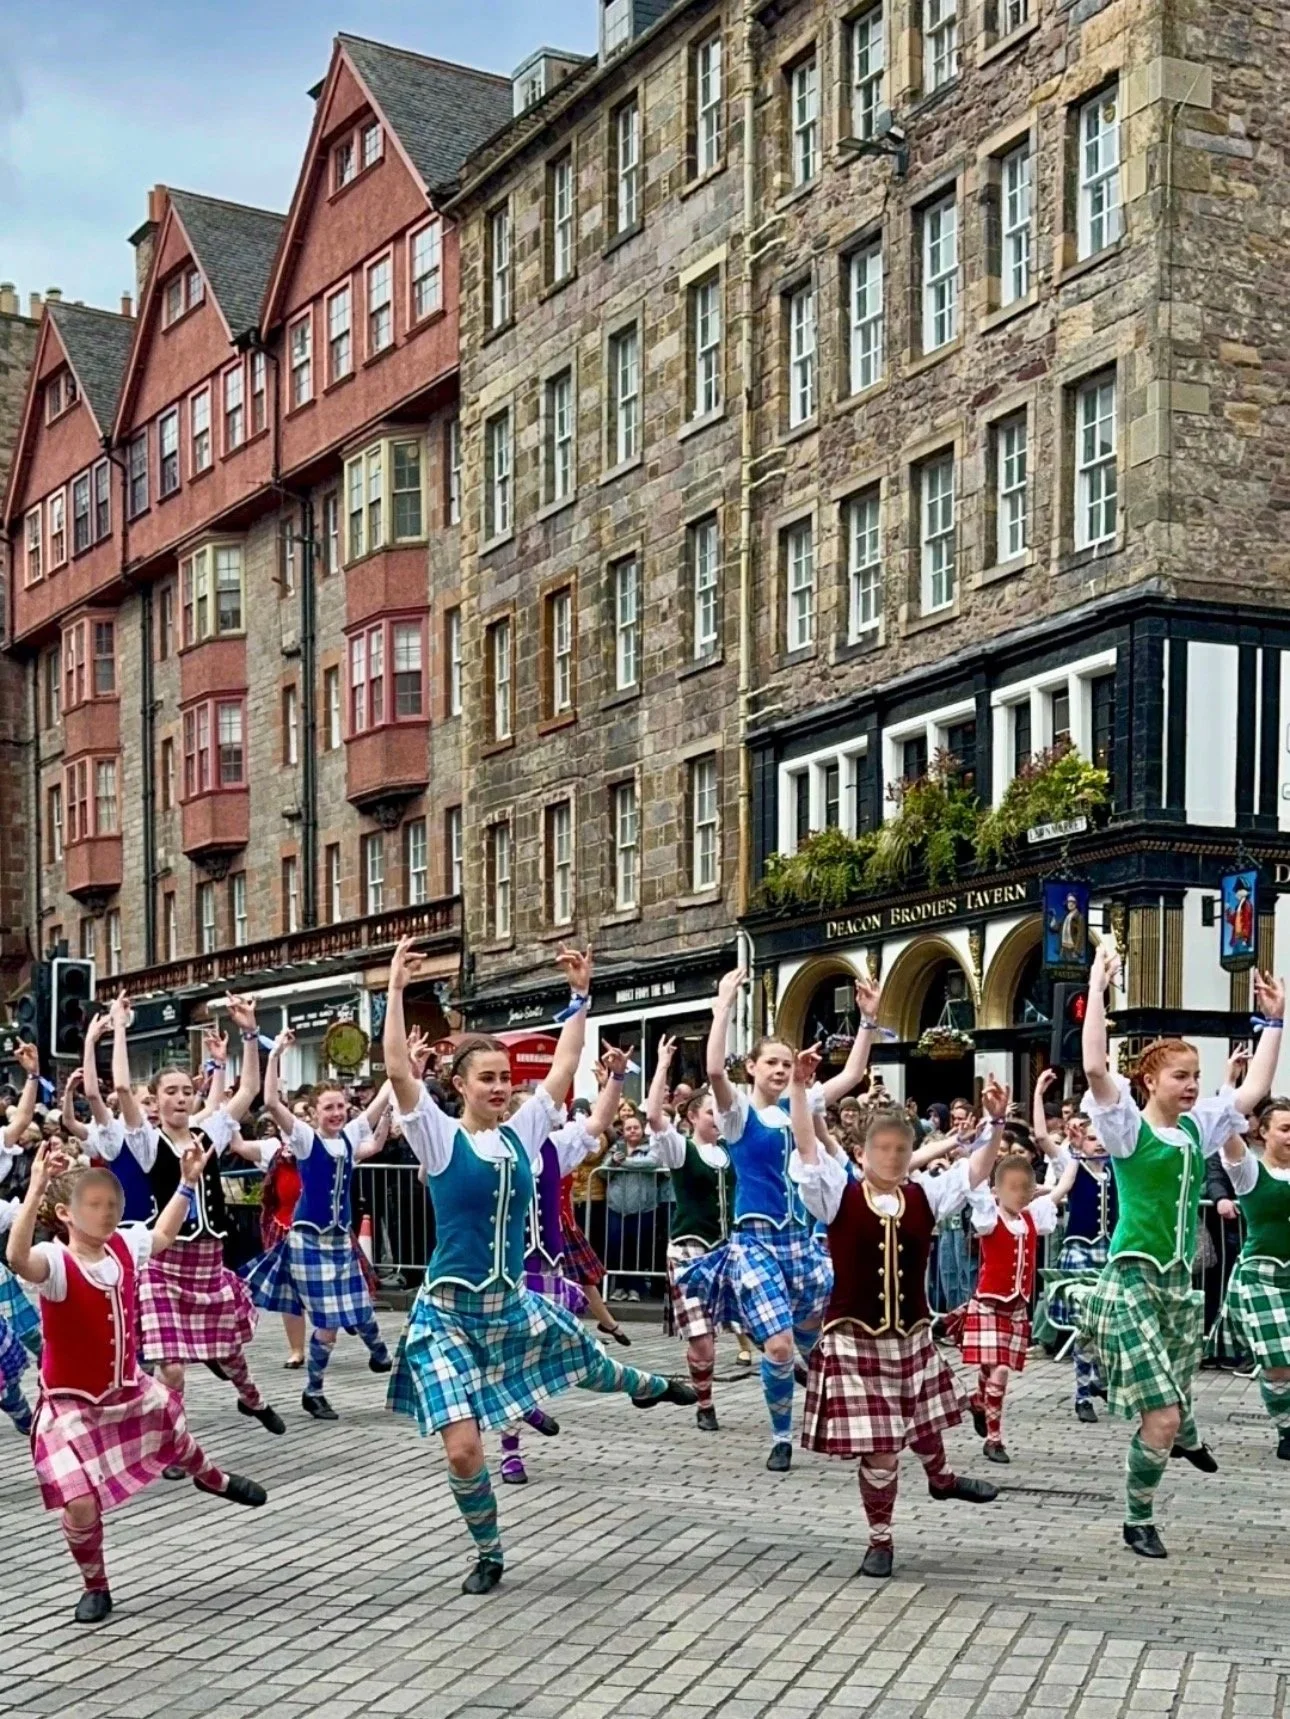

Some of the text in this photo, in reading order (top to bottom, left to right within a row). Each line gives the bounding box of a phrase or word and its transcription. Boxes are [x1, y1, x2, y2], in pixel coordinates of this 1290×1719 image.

[826, 882, 1027, 939] DEACON BRODIE'S TAVERN
